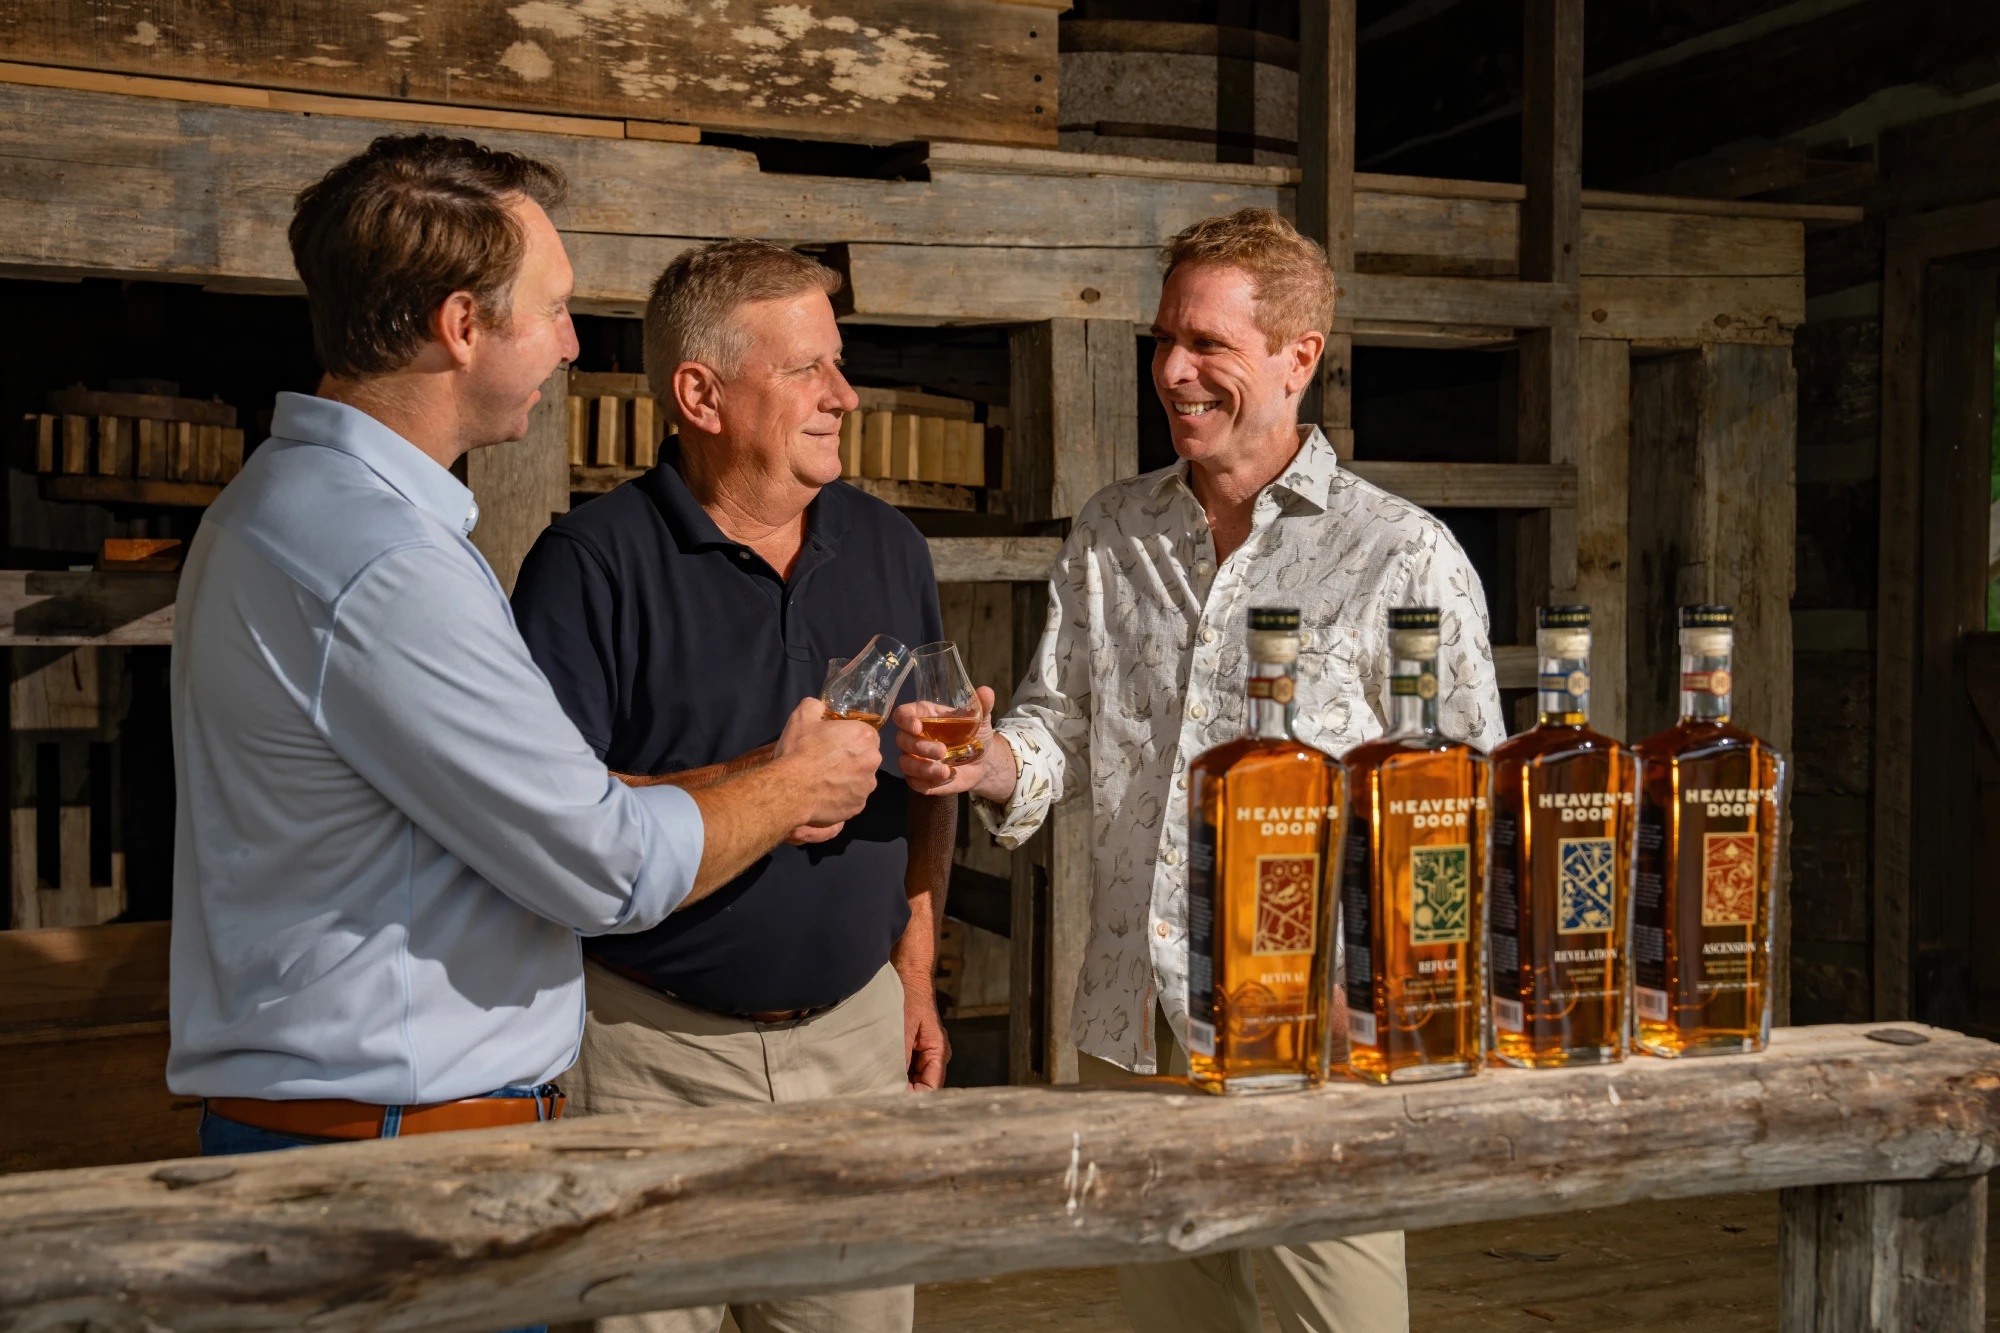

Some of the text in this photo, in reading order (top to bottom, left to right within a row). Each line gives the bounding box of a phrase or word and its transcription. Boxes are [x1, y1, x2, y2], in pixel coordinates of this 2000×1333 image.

[1538, 792, 1633, 808] HEAVEN'S
[1685, 788, 1775, 804] HEAVEN'S
[1236, 805, 1339, 821] HEAVEN'S
[1389, 796, 1487, 815] HEAVEN'S
[1706, 803, 1757, 817] DOOR
[1413, 812, 1467, 829] DOOR
[1561, 807, 1613, 822] DOOR
[1260, 821, 1317, 836] DOOR
[1554, 947, 1618, 963] REVELATION
[1702, 941, 1756, 955] ASCENSION
